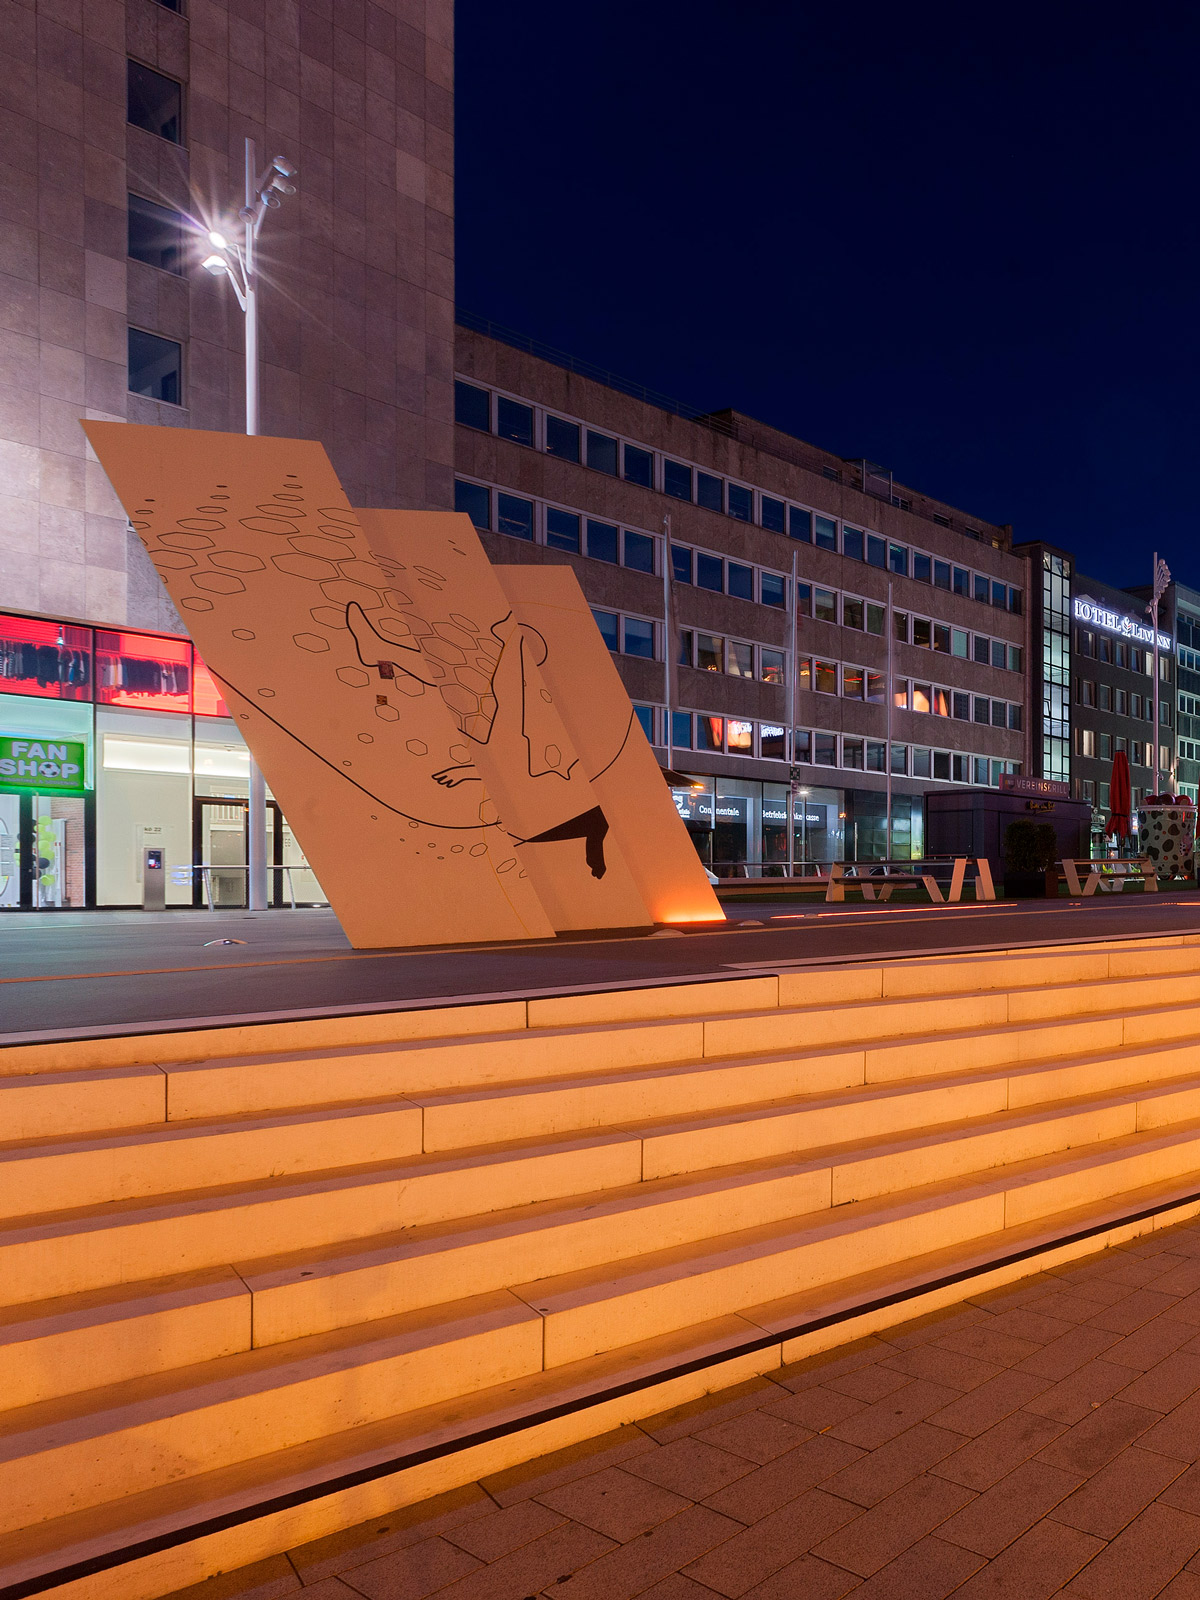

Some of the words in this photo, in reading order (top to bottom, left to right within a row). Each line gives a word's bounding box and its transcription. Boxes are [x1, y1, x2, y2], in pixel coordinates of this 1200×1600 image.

[12, 741, 67, 761] FAN
[0, 758, 80, 779] SHOP
[1016, 779, 1067, 794] VEREINSGRILL
[699, 805, 739, 816] Connentale
